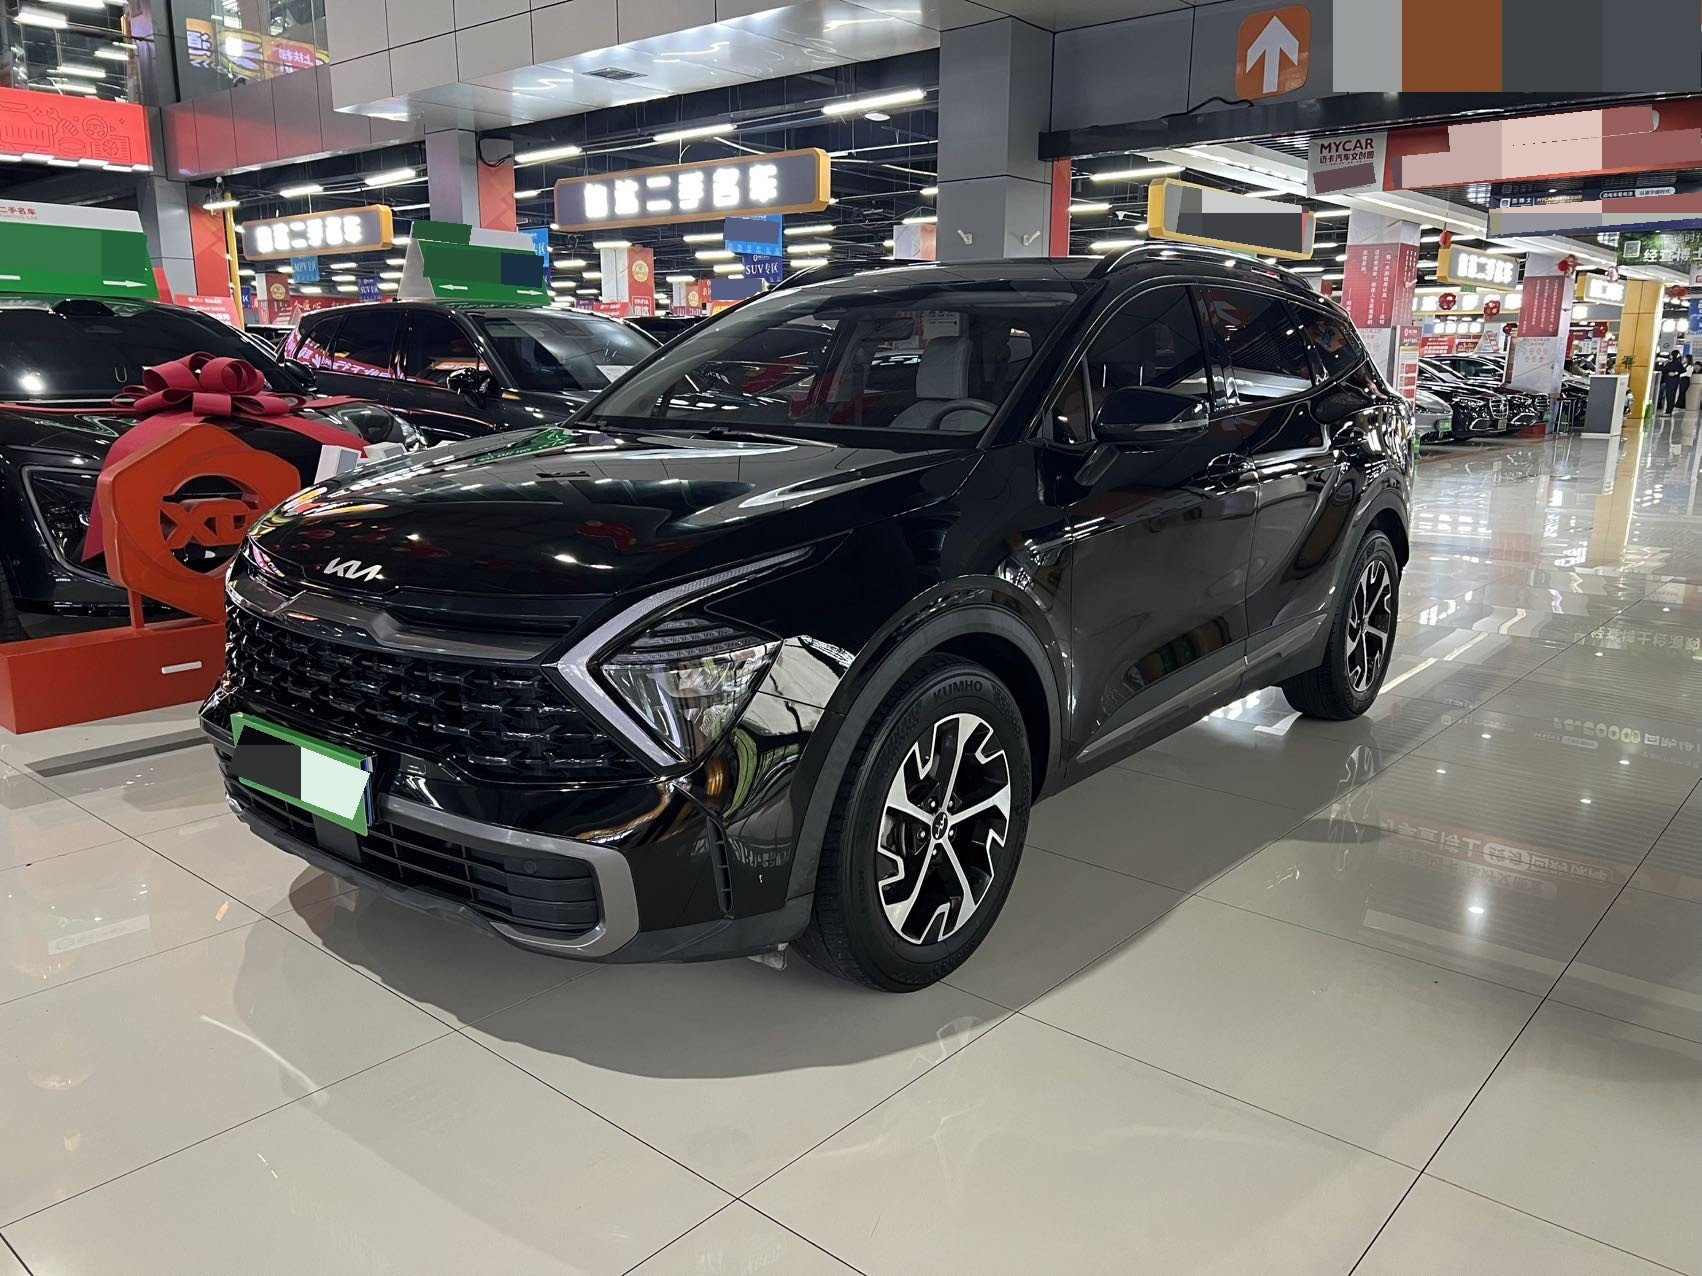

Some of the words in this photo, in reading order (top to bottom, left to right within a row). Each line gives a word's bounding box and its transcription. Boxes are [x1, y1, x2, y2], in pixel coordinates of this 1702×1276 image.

[1319, 138, 1375, 155] MYCAR
[1319, 150, 1376, 165] 迈卡汽车文创园
[323, 557, 383, 582] KIA
[932, 680, 983, 700] KUMHO
